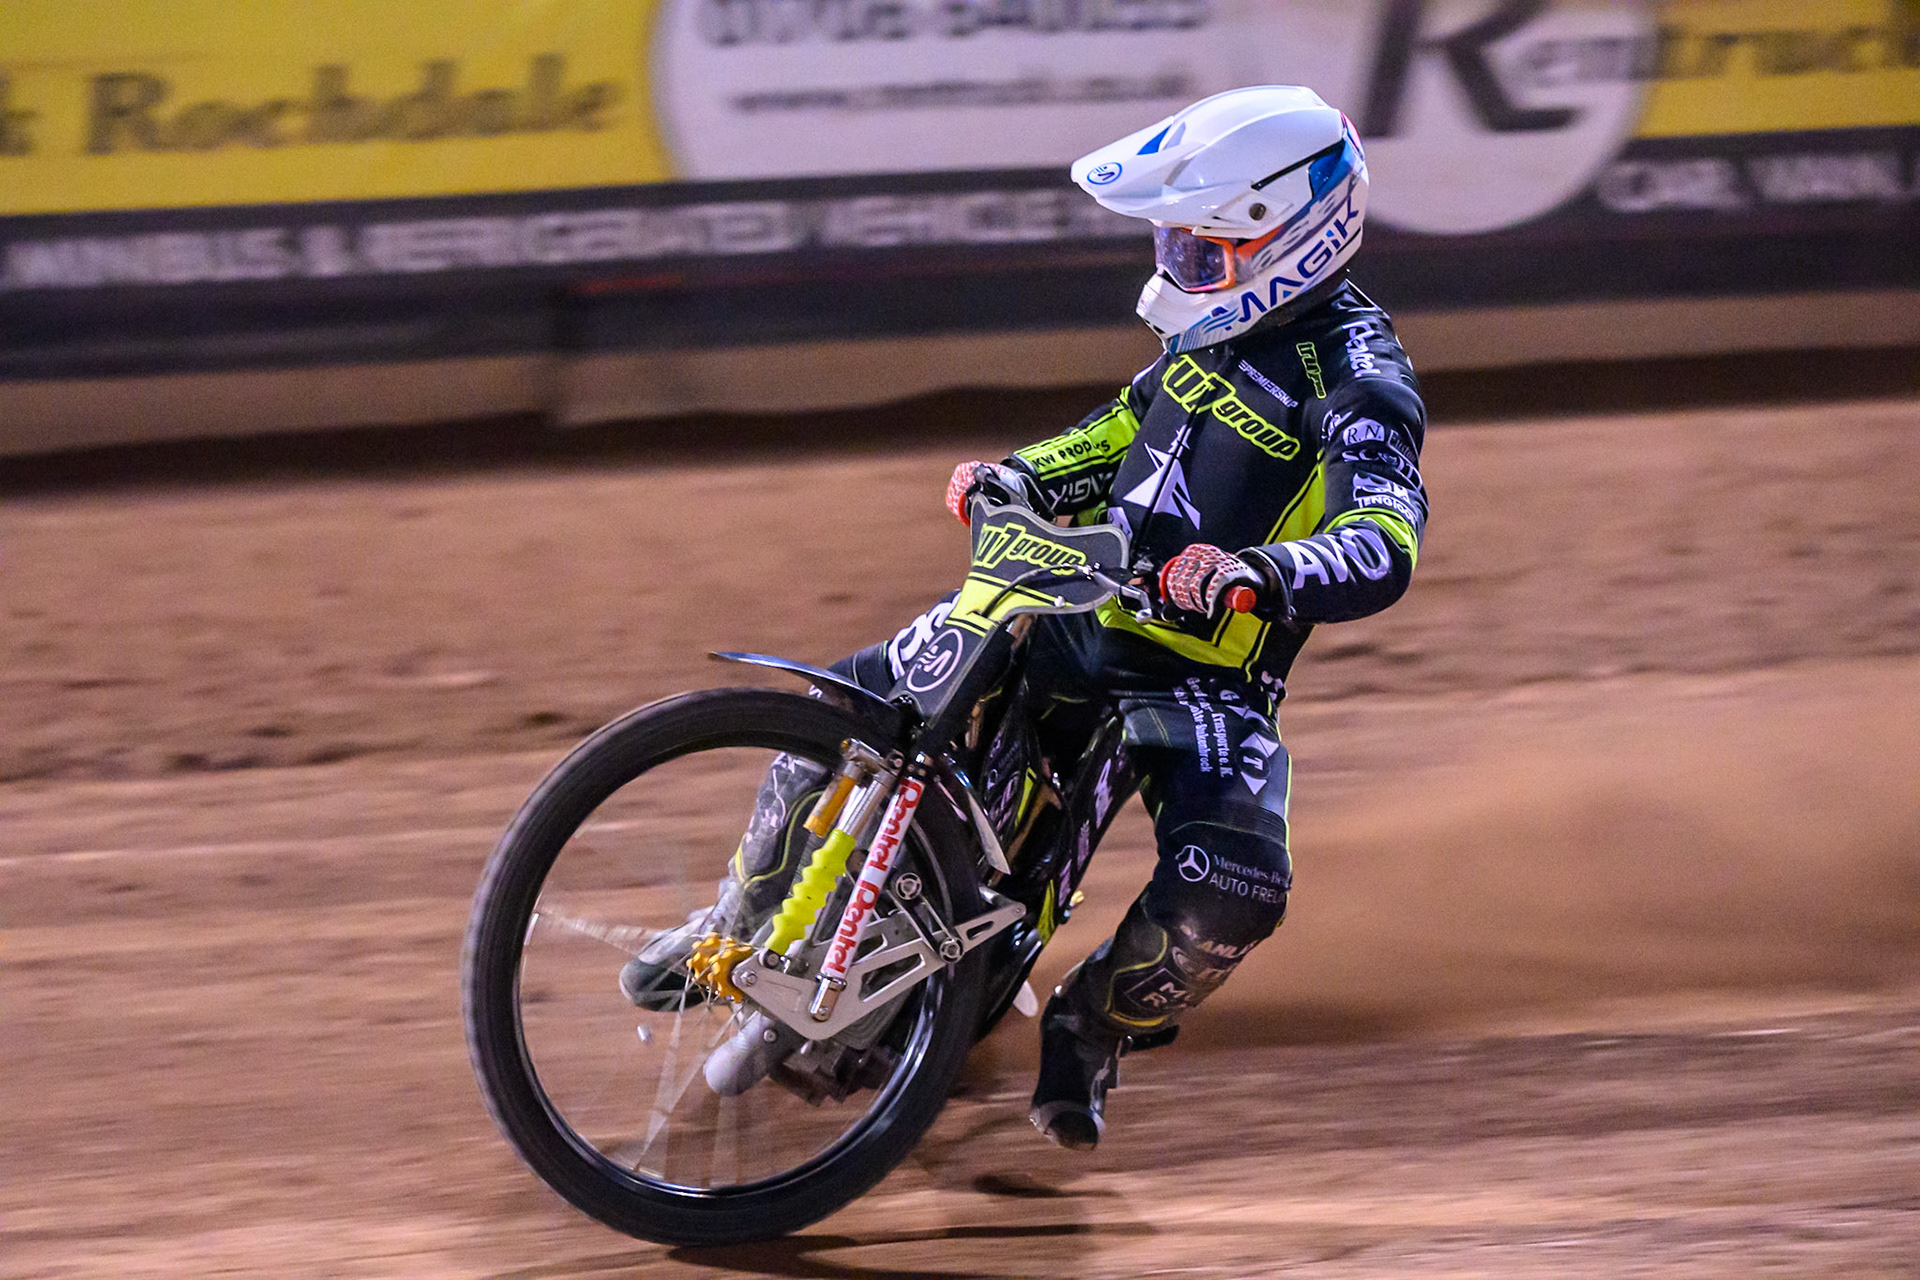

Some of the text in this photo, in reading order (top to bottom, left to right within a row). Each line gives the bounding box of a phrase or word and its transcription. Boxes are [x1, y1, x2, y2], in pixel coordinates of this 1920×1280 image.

[1032, 455, 1056, 469] KW
[1281, 528, 1388, 590] AVO
[1208, 872, 1249, 896] AUTO
